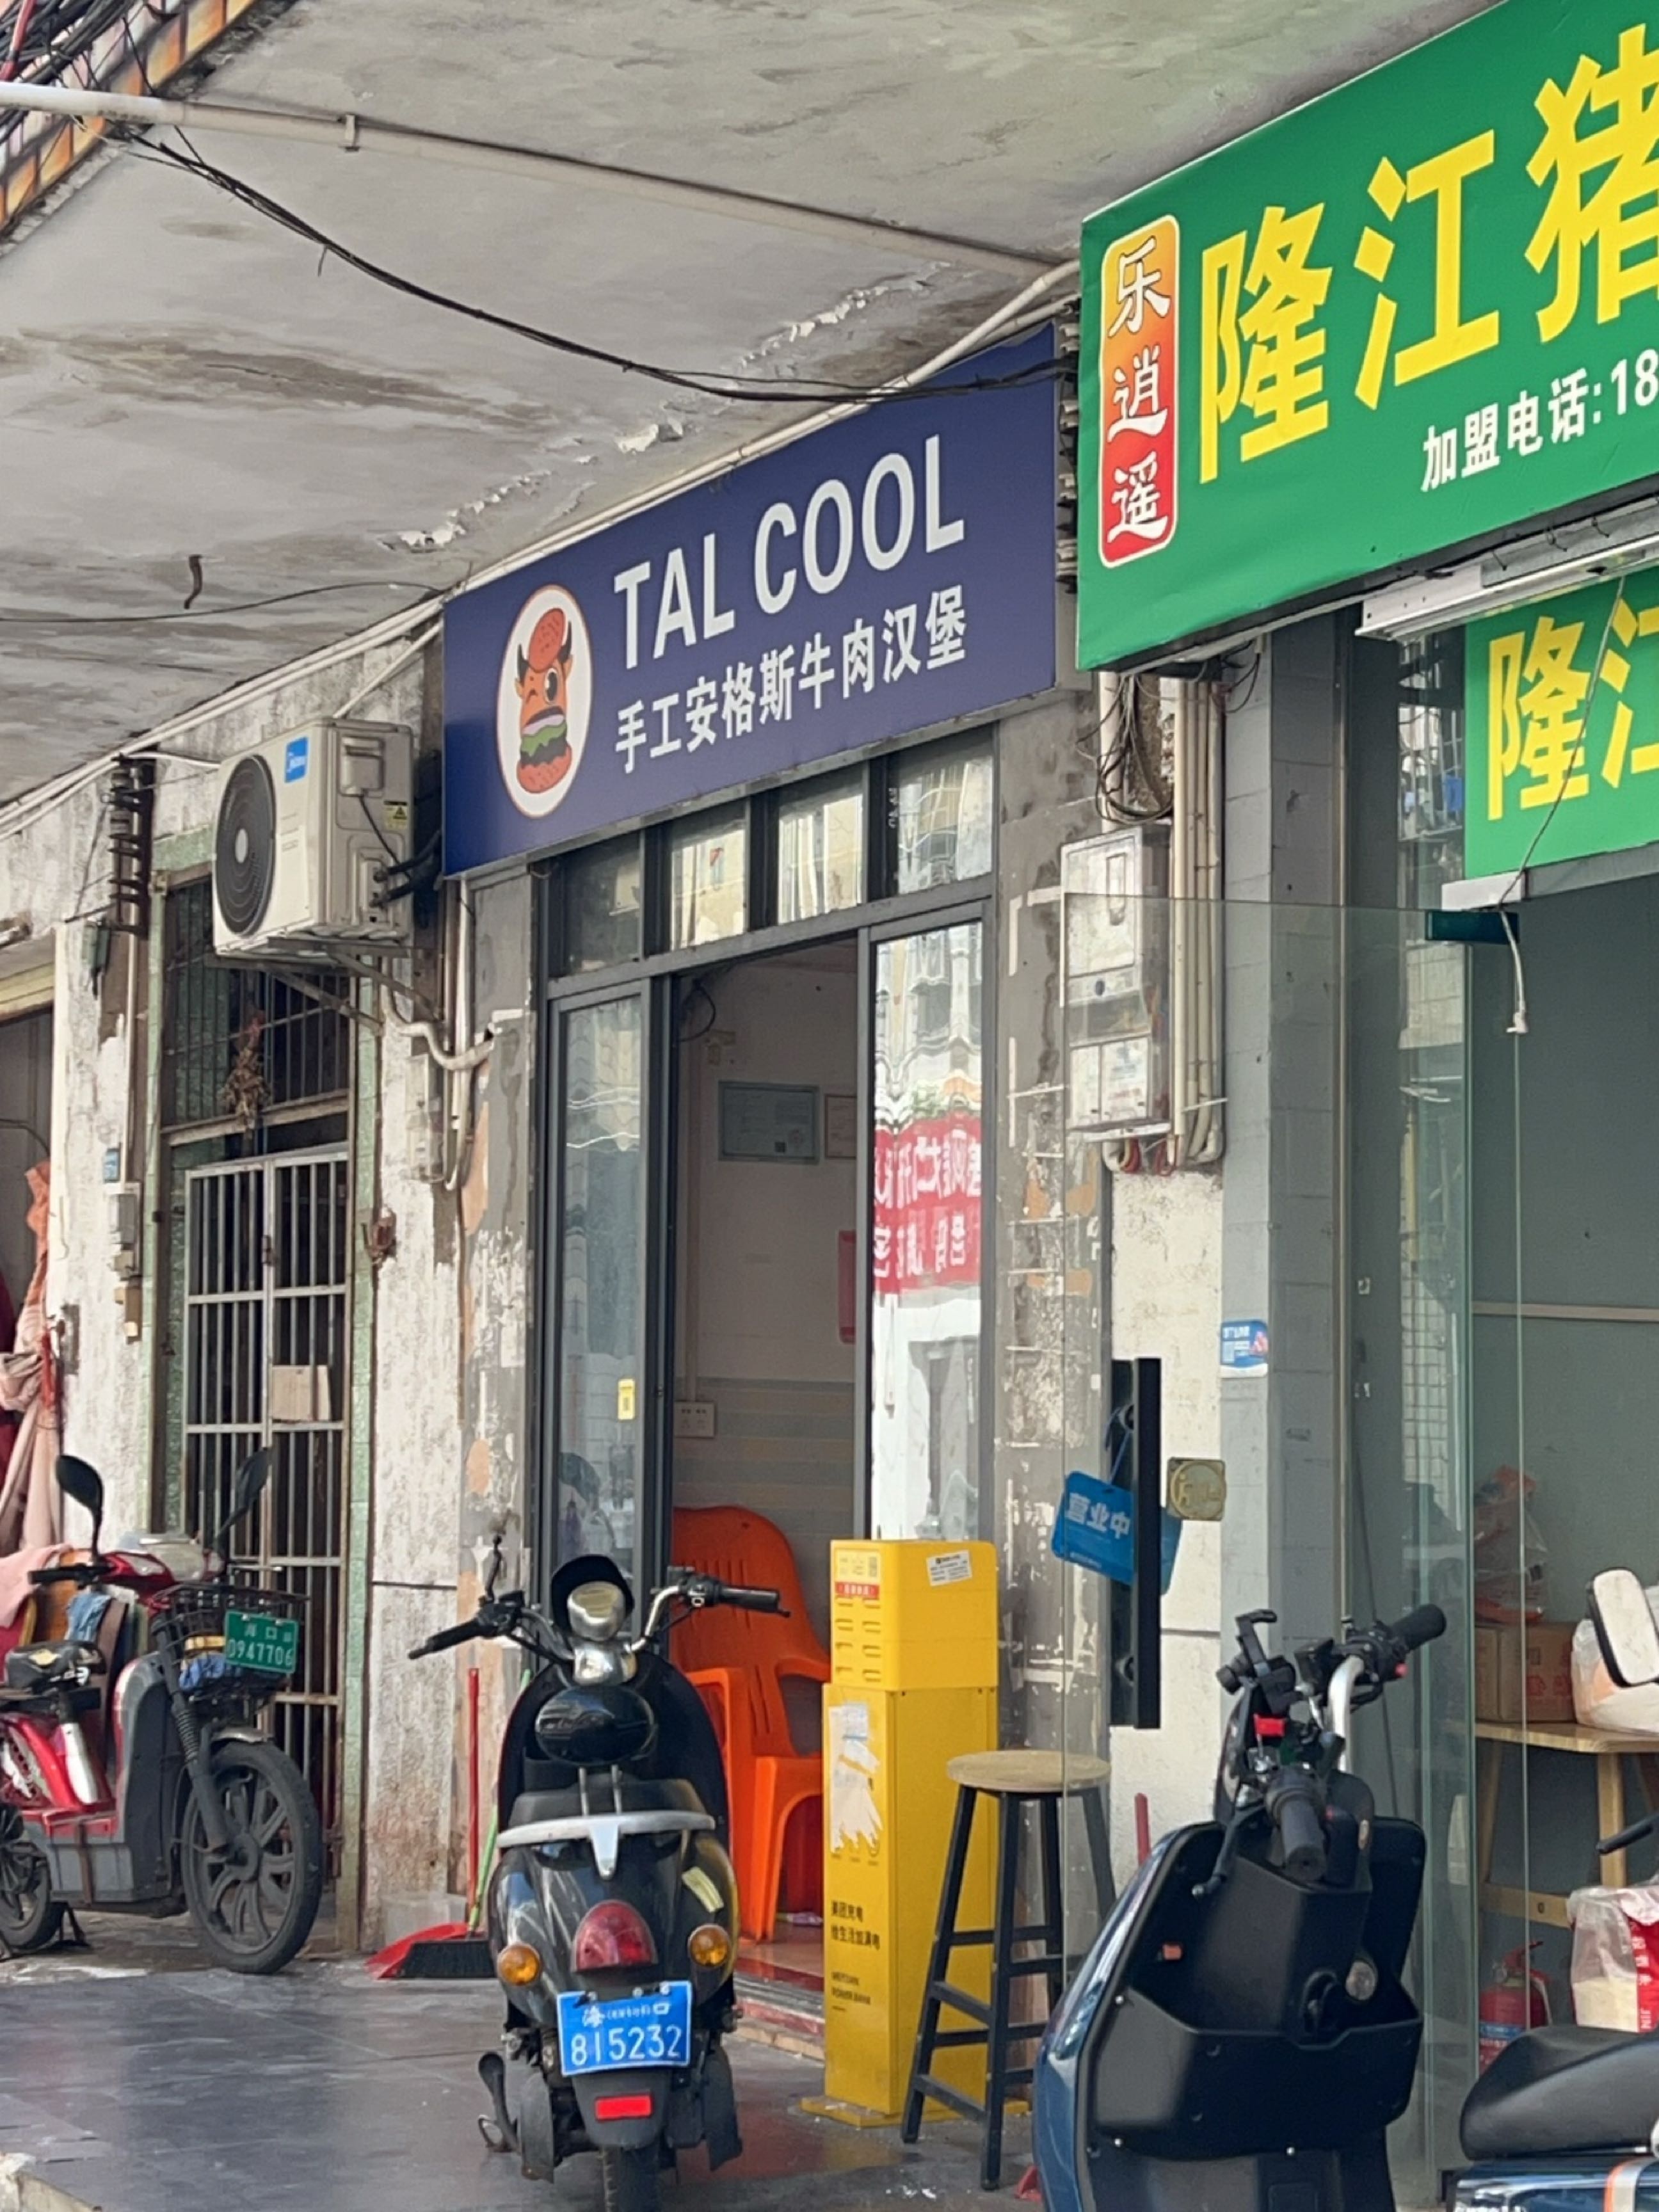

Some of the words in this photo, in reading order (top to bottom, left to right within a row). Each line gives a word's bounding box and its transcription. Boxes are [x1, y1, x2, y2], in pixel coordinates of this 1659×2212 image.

[1199, 22, 1659, 485] 隆江猪
[1107, 236, 1171, 545] 乐逍遥
[613, 533, 736, 670] TAL
[754, 433, 965, 614] COOL
[614, 584, 968, 775] 手工安格斯牛肉汉堡
[1065, 1493, 1131, 1539] 营业中
[228, 1639, 293, 1666] 0947706
[570, 2024, 682, 2066] 815232
